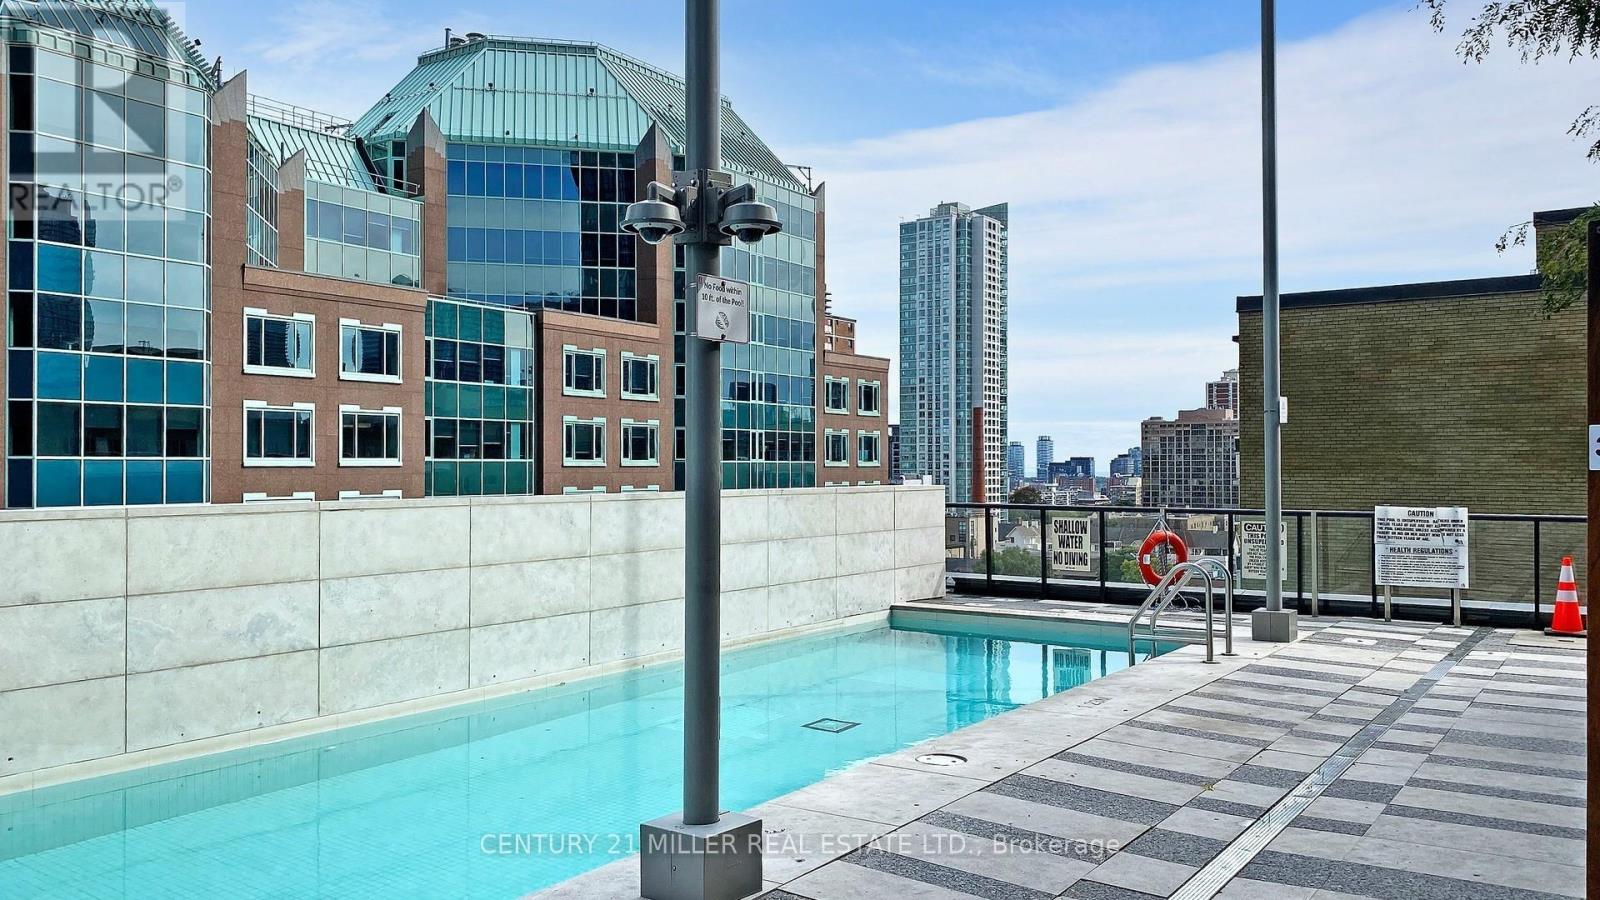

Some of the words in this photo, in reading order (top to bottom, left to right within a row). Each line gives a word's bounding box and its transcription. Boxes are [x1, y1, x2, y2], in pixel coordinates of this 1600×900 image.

[703, 282, 712, 290] No
[713, 283, 726, 293] Food
[726, 286, 743, 296] within
[716, 295, 721, 303] of
[722, 296, 731, 304] the
[1053, 520, 1088, 534] SHALLOW
[1057, 535, 1083, 549] WATER
[1053, 551, 1063, 565] NO
[1064, 551, 1088, 566] DIVING
